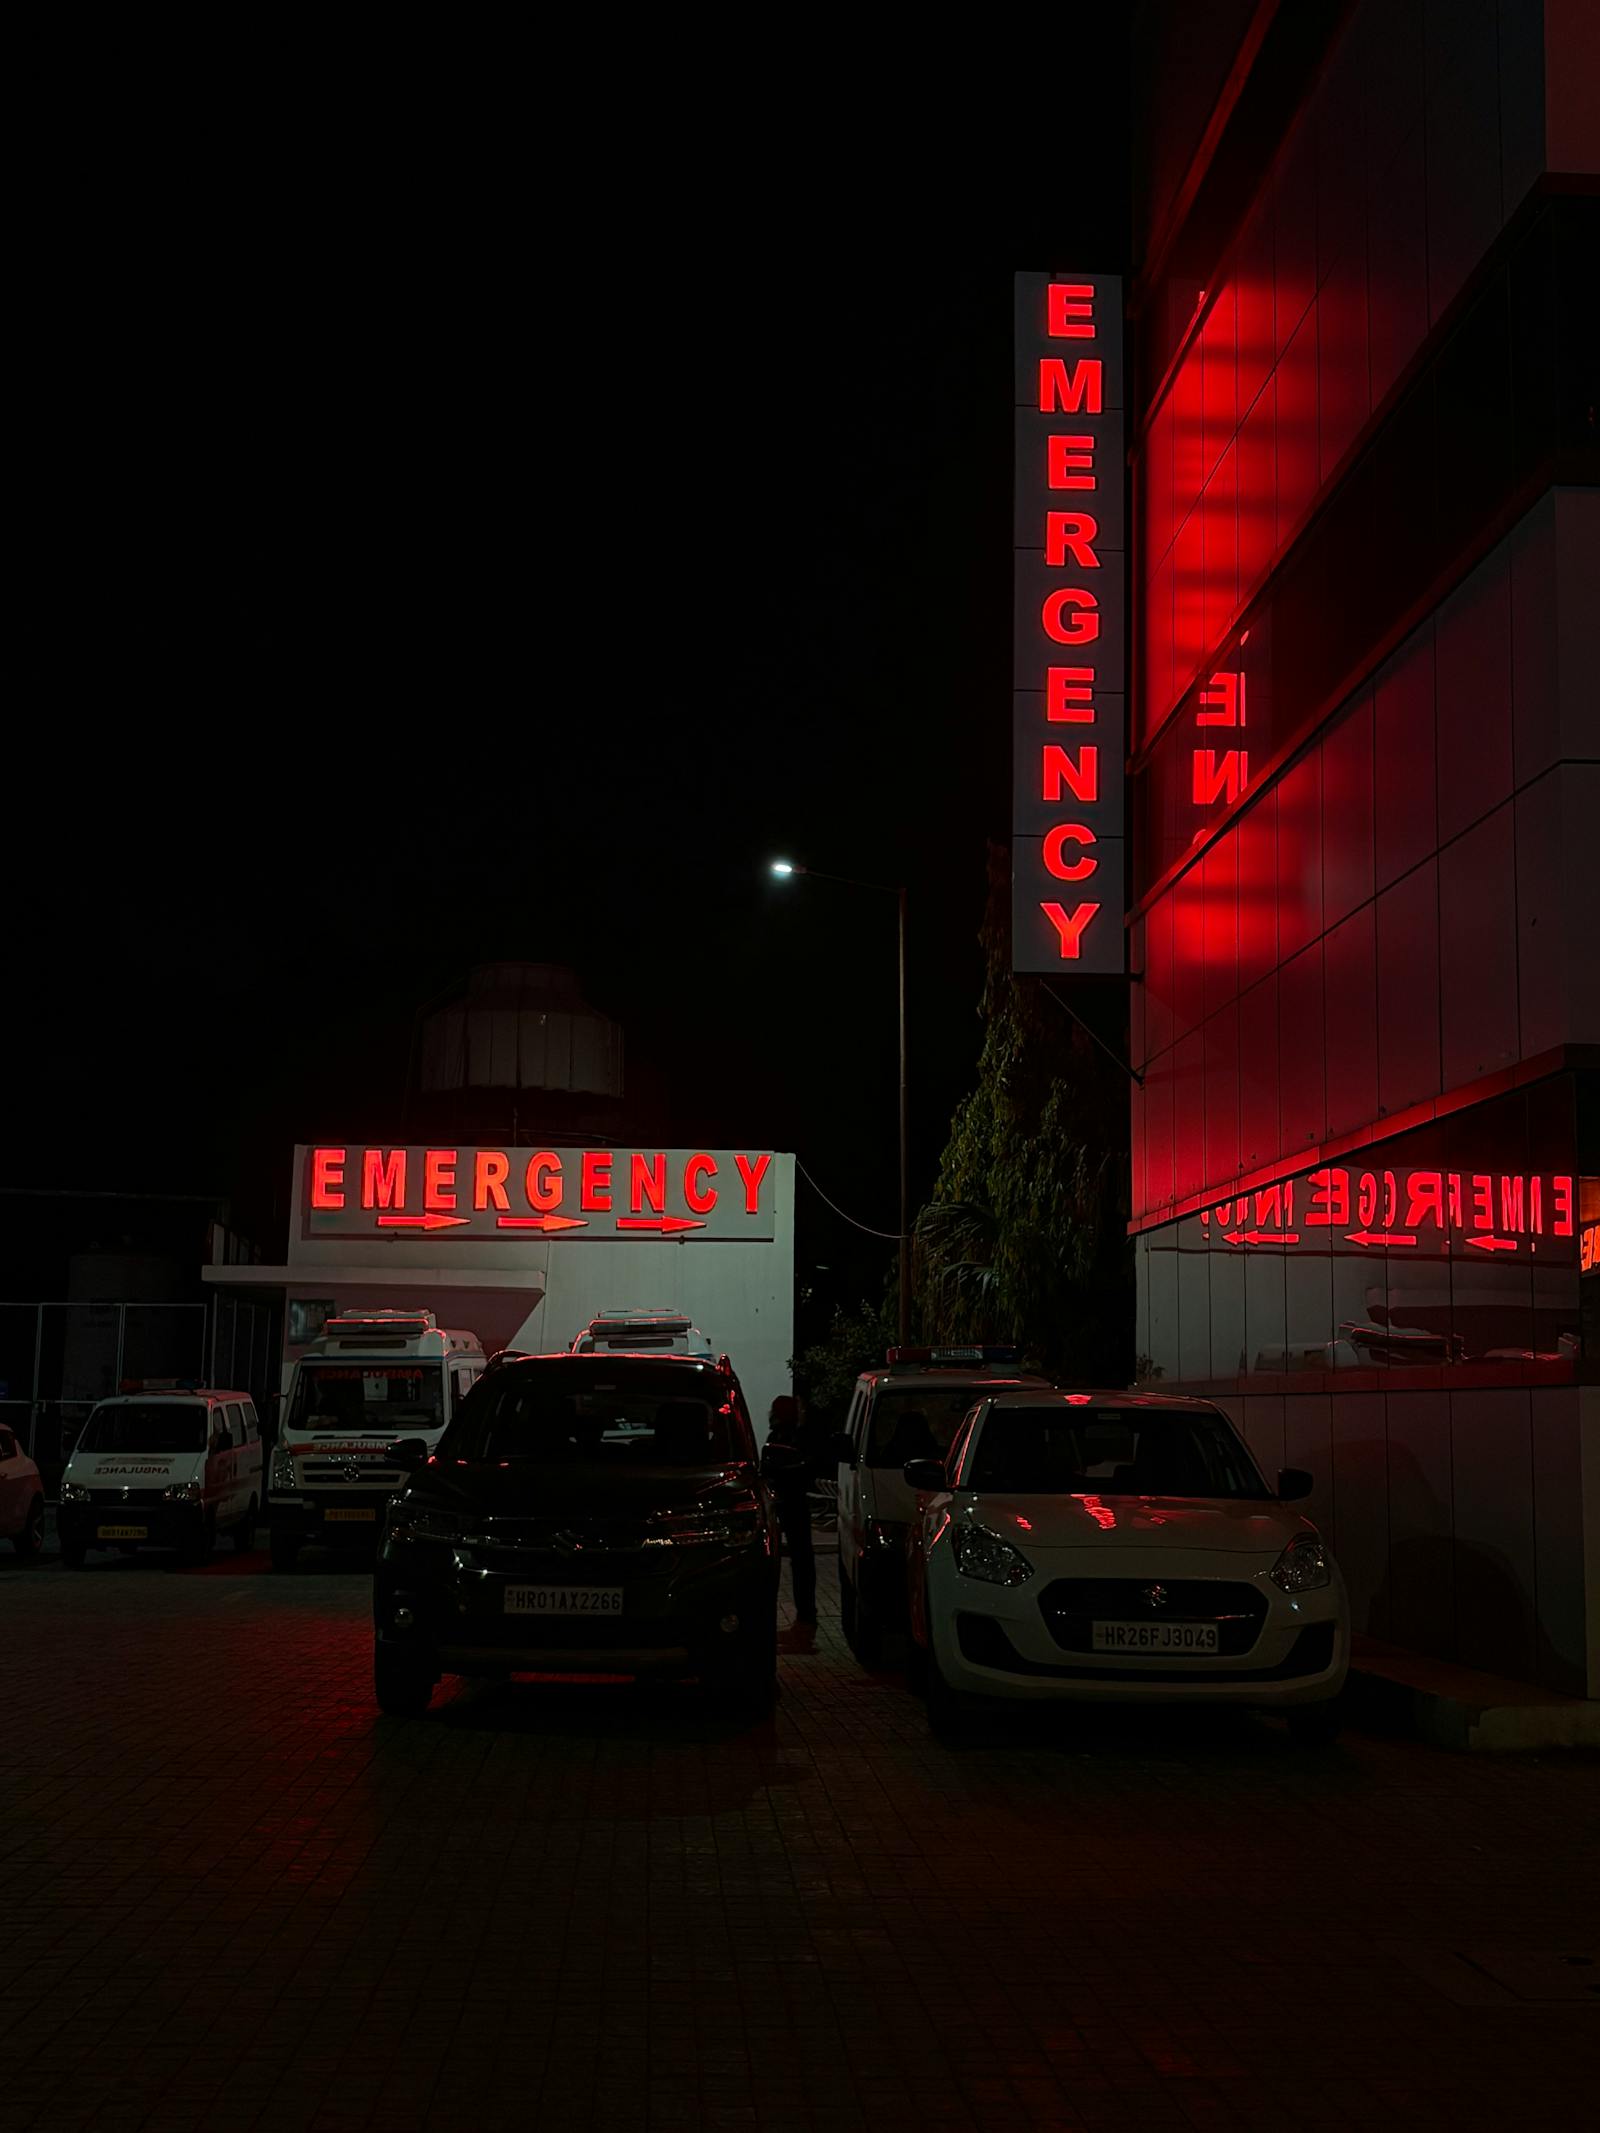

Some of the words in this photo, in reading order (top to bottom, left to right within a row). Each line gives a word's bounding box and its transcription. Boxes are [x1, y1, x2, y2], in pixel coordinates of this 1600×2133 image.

[1038, 283, 1102, 962] EMERGENCY
[311, 1148, 772, 1213] EMERGENCY
[516, 1591, 621, 1610] HR01AX2266
[1105, 1627, 1217, 1648] HR26FJ3049
